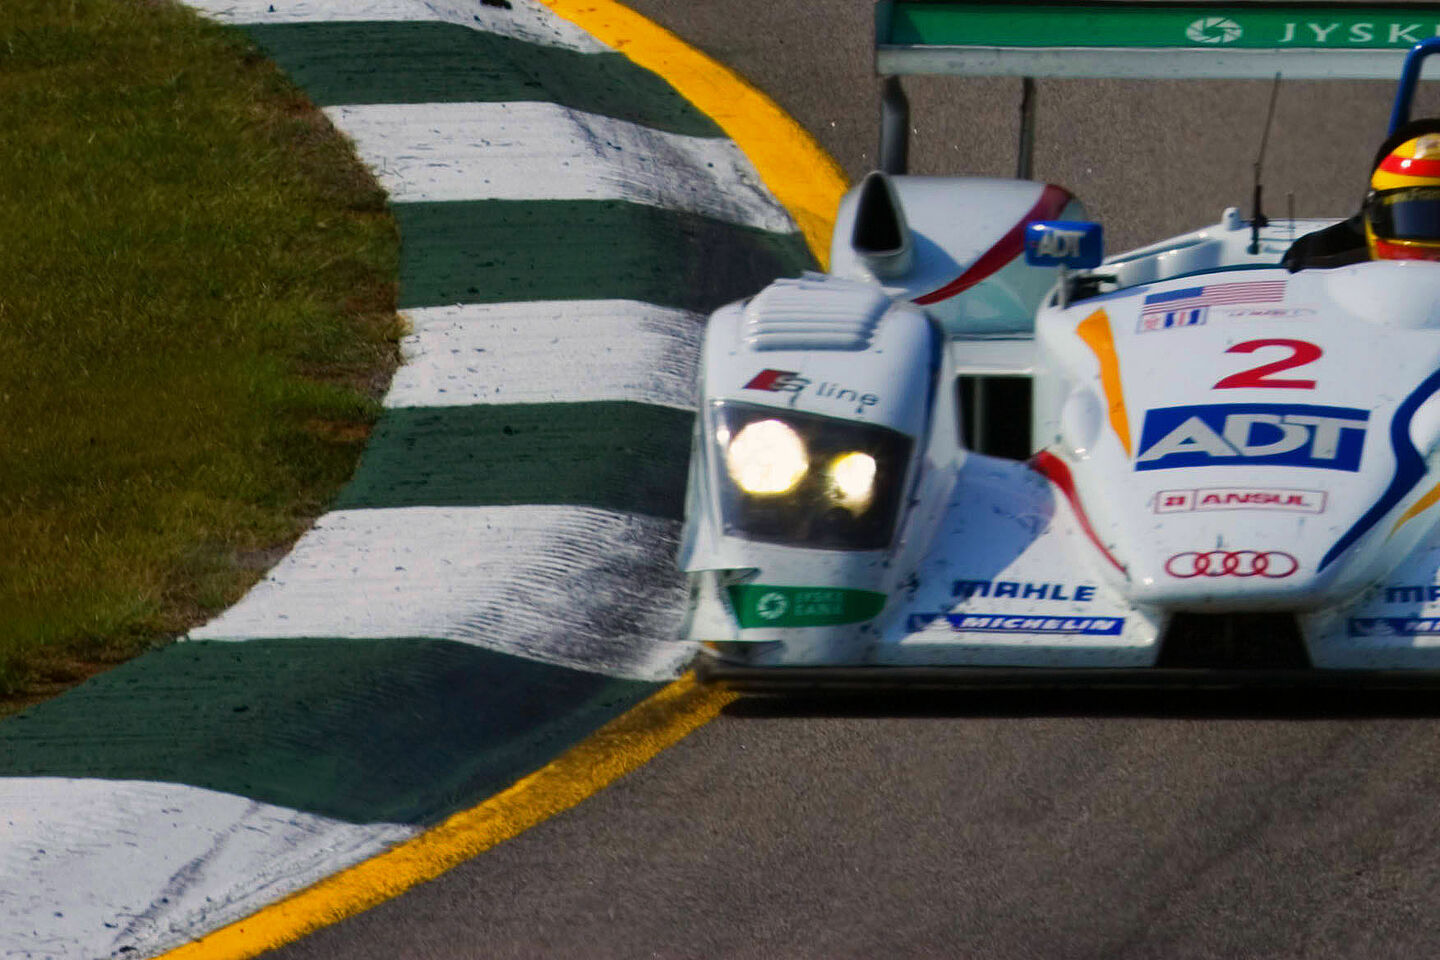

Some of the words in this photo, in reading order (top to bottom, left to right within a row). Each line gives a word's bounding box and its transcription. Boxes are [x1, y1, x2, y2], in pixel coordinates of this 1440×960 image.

[1037, 229, 1087, 258] ADT
[1211, 338, 1324, 390] 2
[816, 381, 880, 407] line
[1137, 413, 1370, 462] ADT
[952, 579, 1097, 602] MAHLE
[959, 616, 1118, 632] MICHELIN
